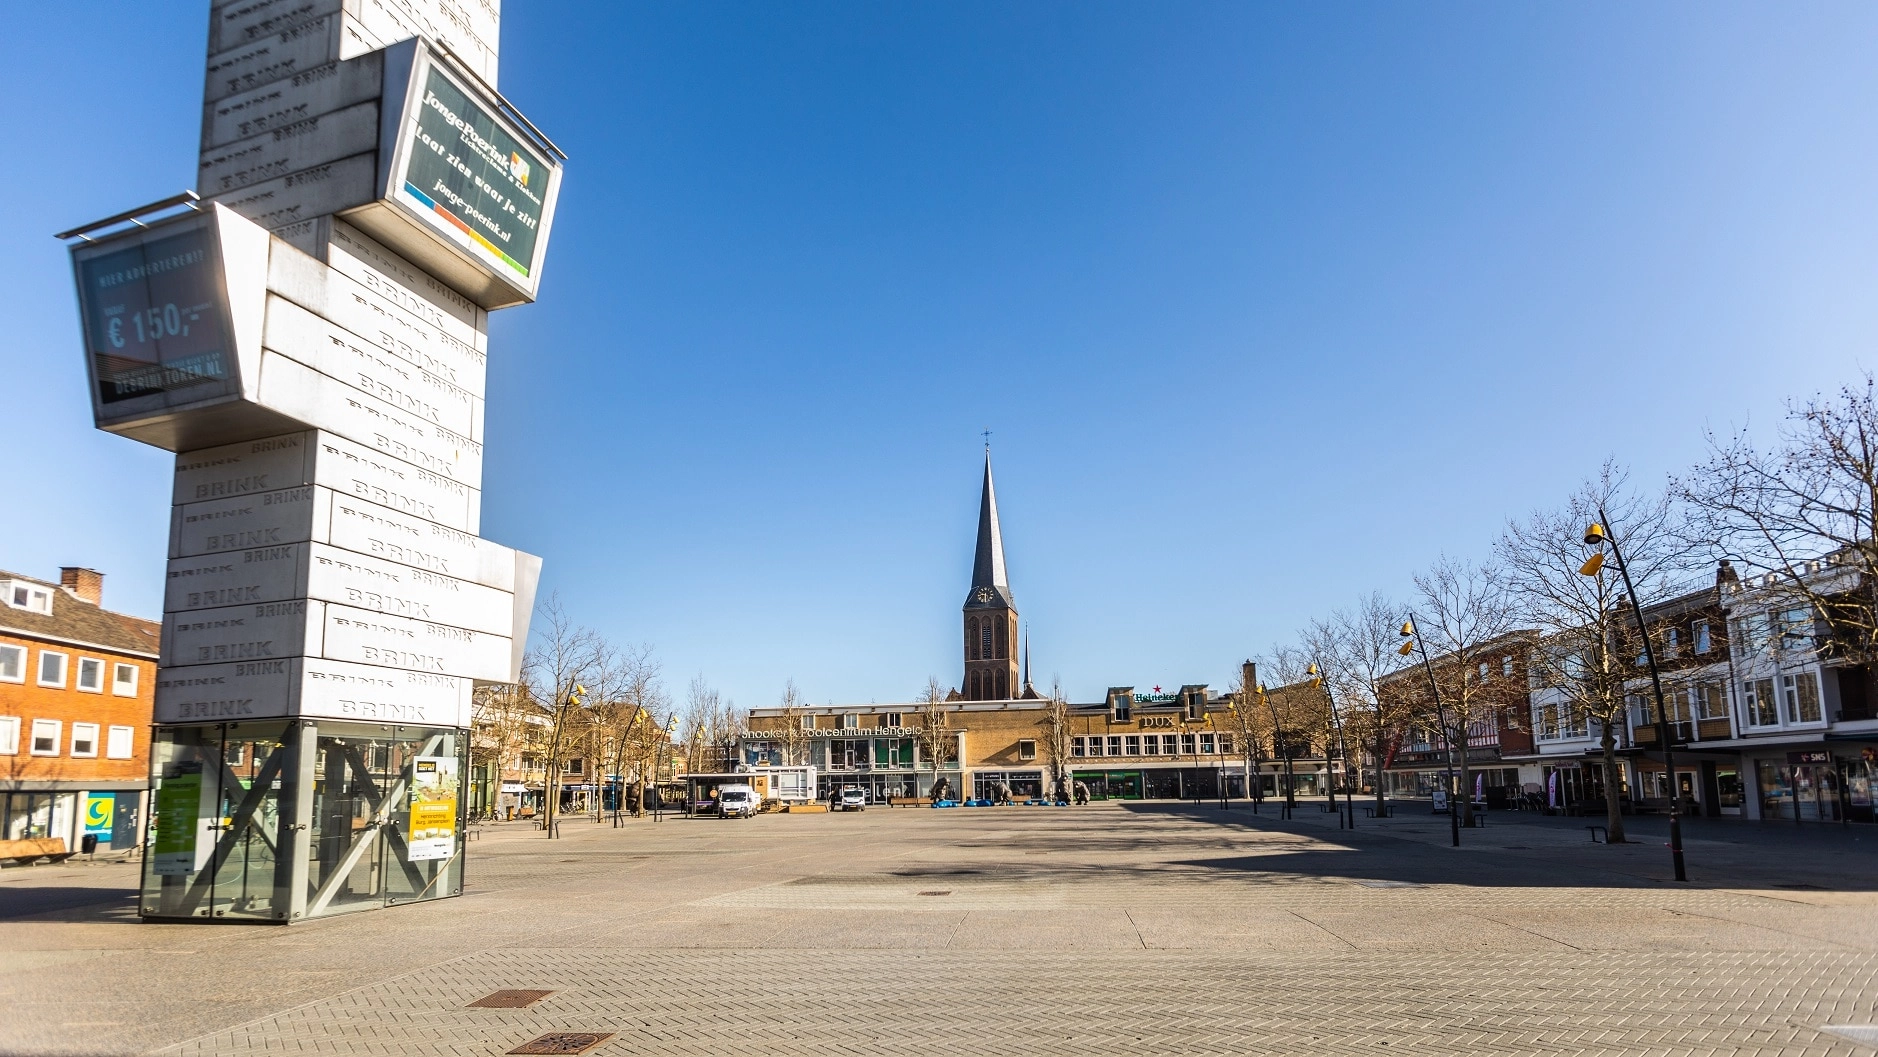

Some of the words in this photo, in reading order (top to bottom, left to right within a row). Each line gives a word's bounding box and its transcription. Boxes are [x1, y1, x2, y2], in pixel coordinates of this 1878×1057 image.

[415, 125, 445, 157] Laat
[446, 152, 473, 178] zien
[475, 175, 505, 203] waar
[502, 199, 516, 214] je
[433, 179, 511, 243] jonge-poerink.nl
[363, 269, 444, 328] BRINK
[426, 278, 472, 313] BRINK
[108, 317, 126, 348] €
[379, 330, 456, 383] BRINK
[440, 332, 484, 366] BRINK
[358, 372, 439, 422] BRINK
[421, 371, 467, 403] BRINK
[374, 432, 452, 476] BRINK
[436, 427, 480, 456] BRINK
[196, 474, 269, 499] BRINK
[417, 469, 464, 496] BRINK
[264, 488, 312, 506] BRINK
[352, 478, 435, 519] BRINK
[206, 527, 280, 550] BRINK
[431, 524, 476, 548] BRINK
[244, 546, 292, 564] BRINK
[368, 537, 448, 572] BRINK
[412, 569, 459, 591] BRINK
[187, 585, 261, 607] BRINK
[345, 587, 430, 618] BRINK
[255, 601, 305, 618] BRINK
[198, 641, 273, 661] BRINK
[362, 645, 443, 671] BRINK
[236, 661, 285, 677] BRINK
[406, 672, 454, 689] BRINK
[178, 699, 254, 718] BRINK
[339, 700, 425, 720] BRINK
[801, 726, 872, 738] Poolcentrum
[874, 725, 923, 737] Hengelo
[1143, 716, 1176, 727] DUX
[1810, 753, 1826, 761] SNS
